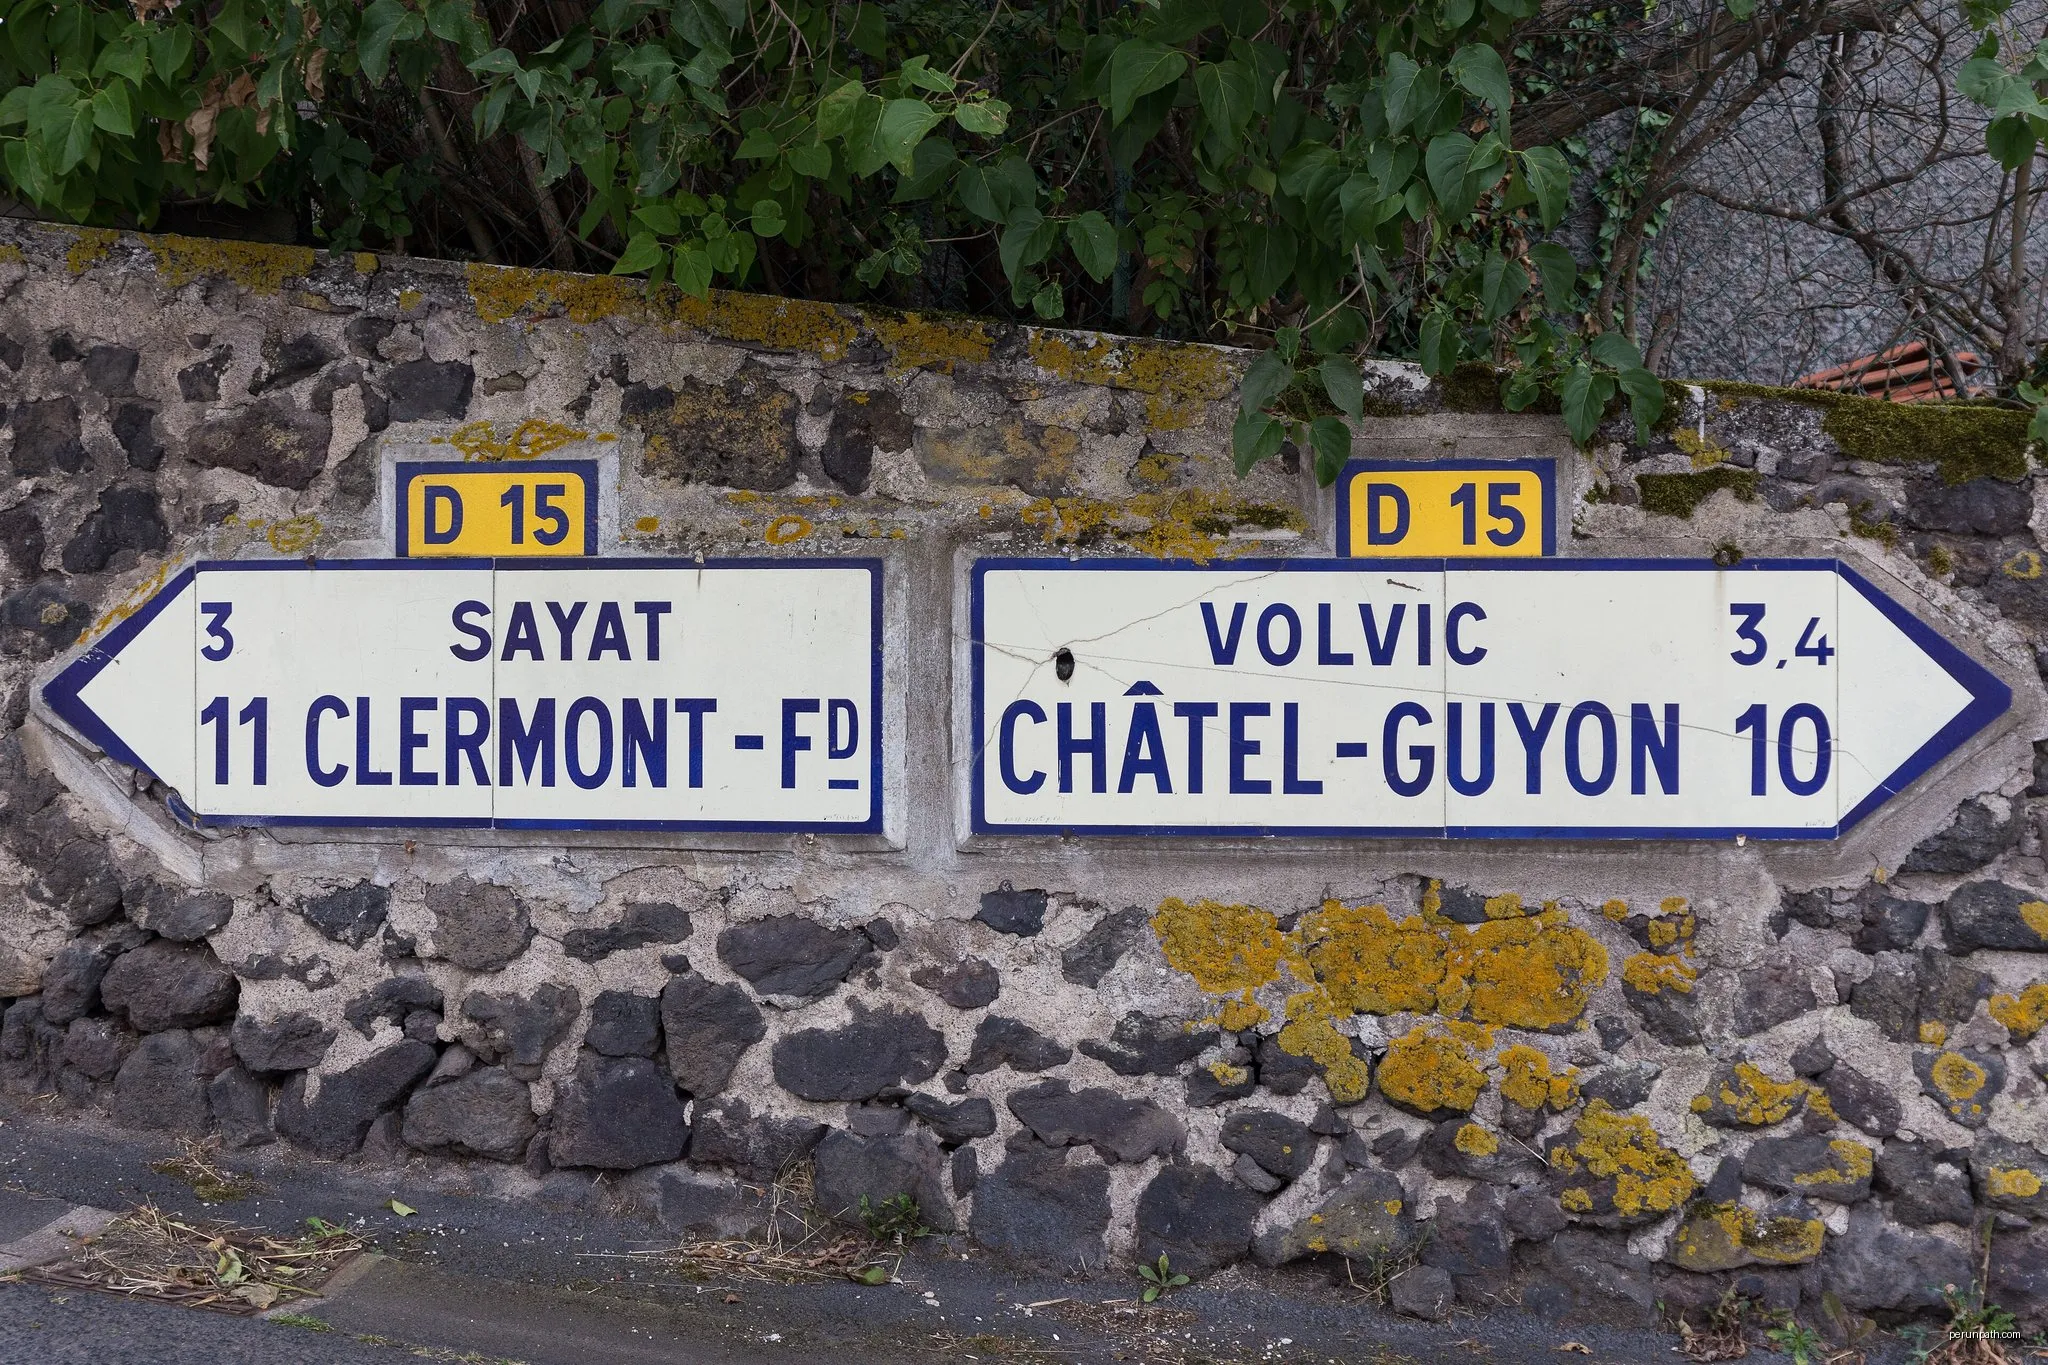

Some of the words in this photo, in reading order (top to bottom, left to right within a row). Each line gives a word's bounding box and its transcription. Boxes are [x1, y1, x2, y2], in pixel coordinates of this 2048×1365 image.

[425, 485, 464, 545] D
[501, 485, 570, 546] 15
[1367, 484, 1411, 546] D
[1451, 484, 1528, 548] 15
[201, 601, 234, 662] 3
[450, 600, 672, 662] SAYAT
[1200, 601, 1488, 667] VOLVIC
[1730, 602, 1835, 670] 3,4
[201, 697, 268, 786] 11
[999, 681, 1680, 798] CHÂTEL-GUYON
[1736, 703, 1832, 797] 10
